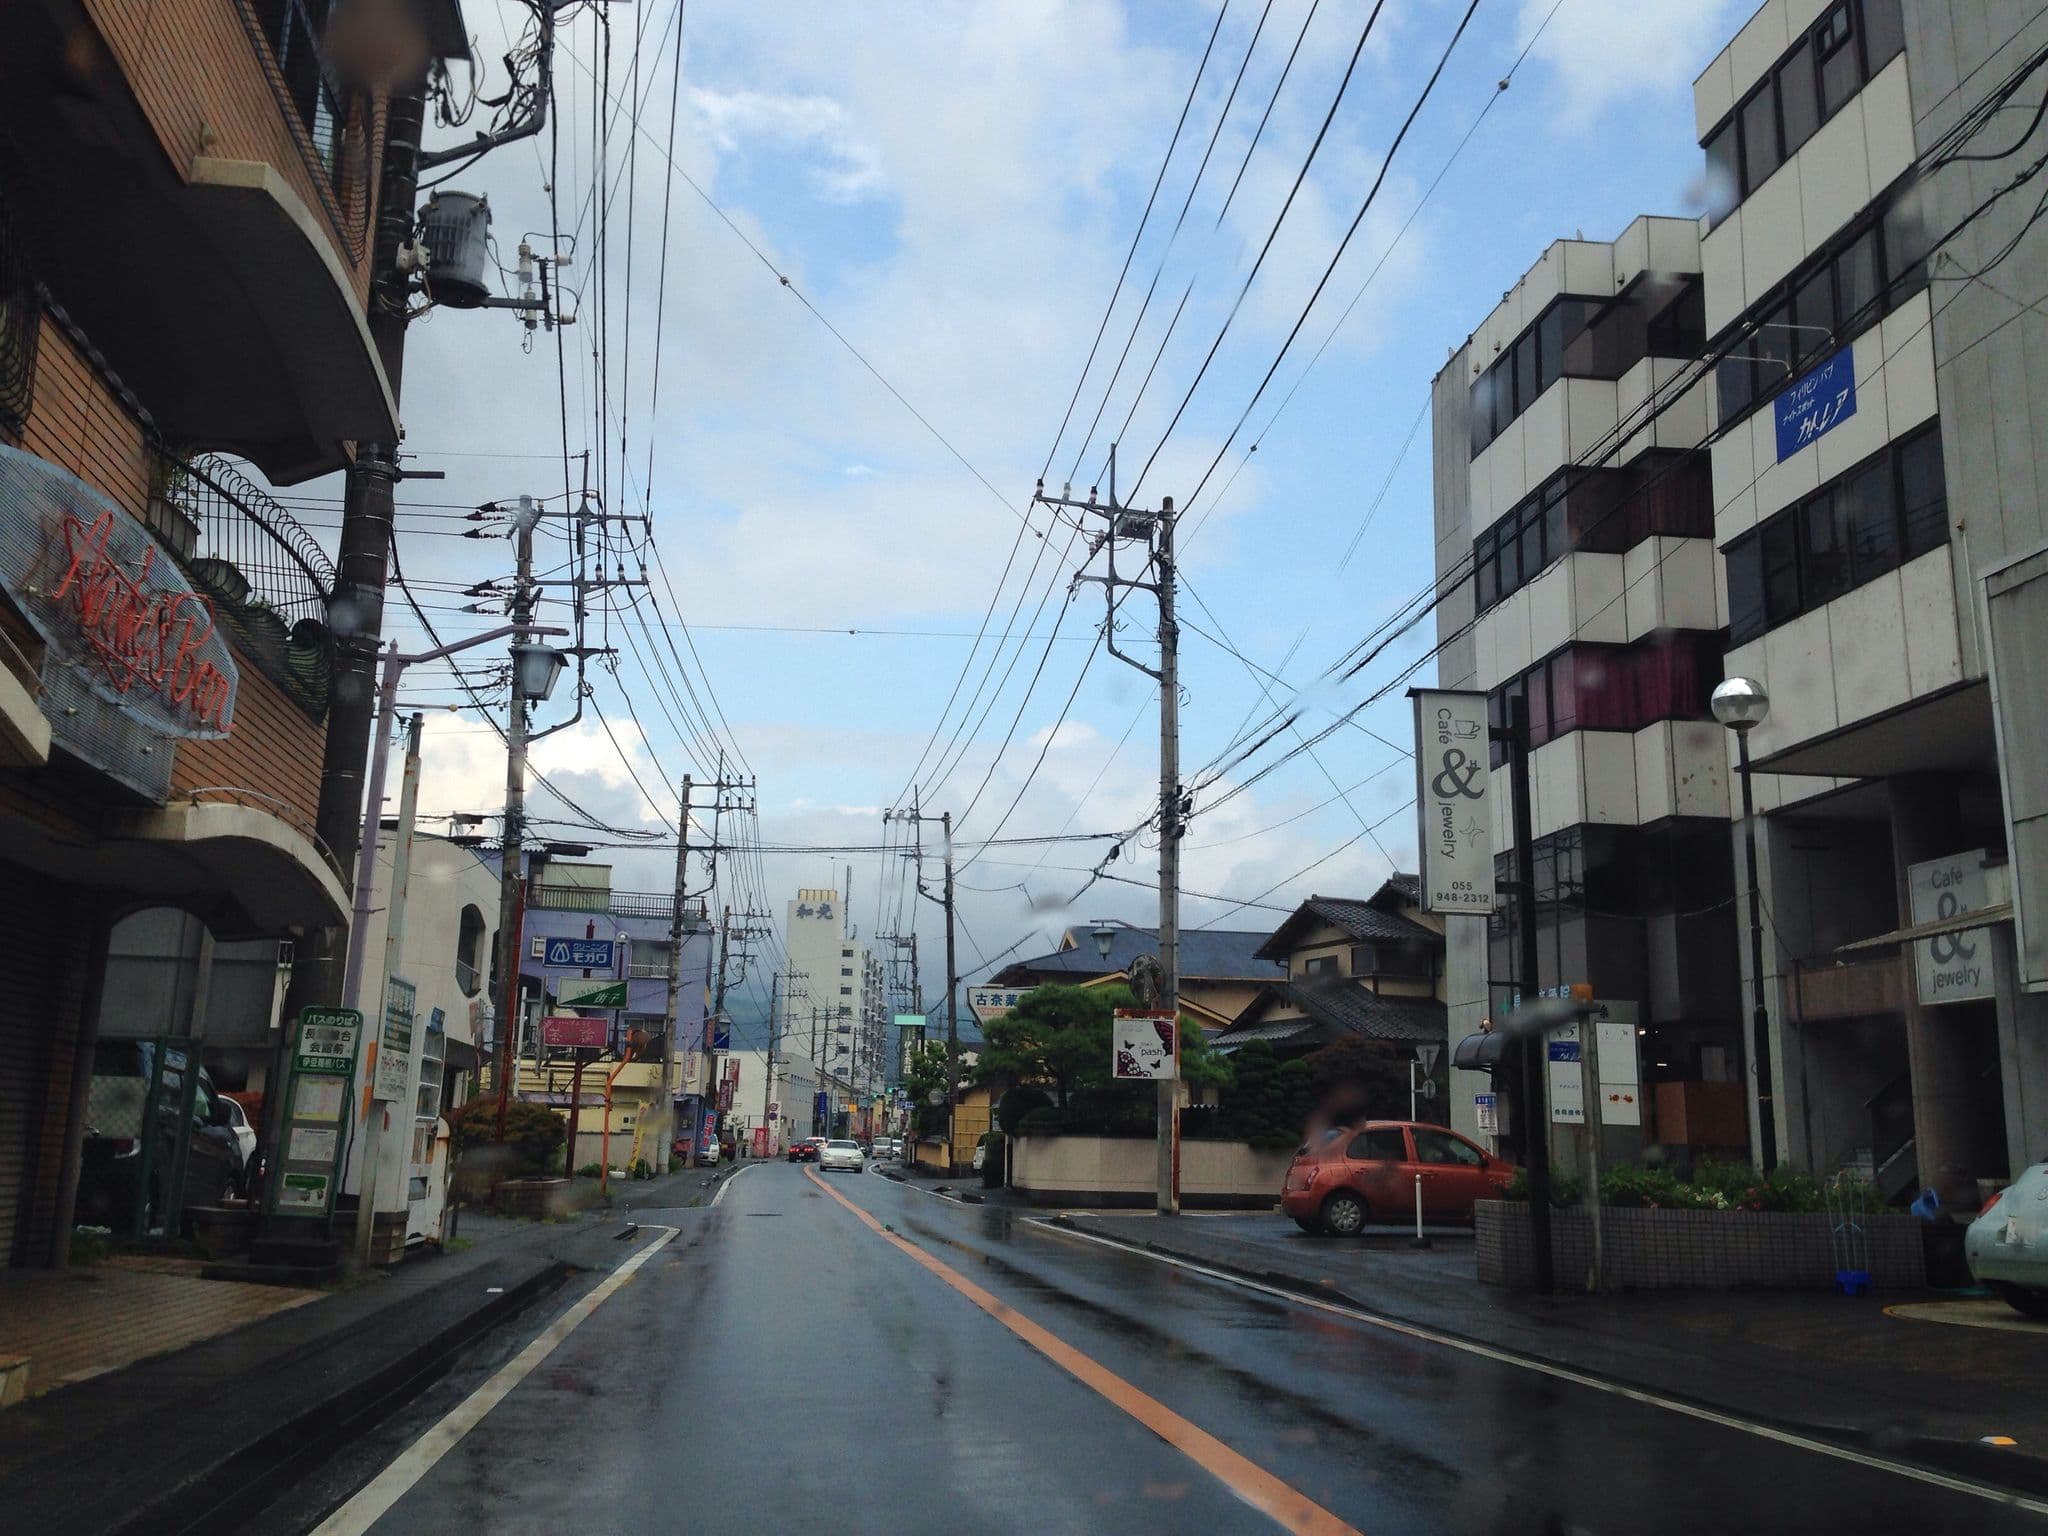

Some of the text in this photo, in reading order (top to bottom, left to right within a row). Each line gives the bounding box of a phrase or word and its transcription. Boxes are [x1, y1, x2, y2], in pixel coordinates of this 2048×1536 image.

[1431, 707, 1485, 860] Café & jewelry
[1451, 880, 1473, 891] 055
[1931, 867, 1964, 889] Café
[1436, 891, 1490, 904] 948-2312
[796, 902, 834, 920] 和光
[1932, 965, 1981, 994] jewelry
[306, 1014, 354, 1026] バスのりば
